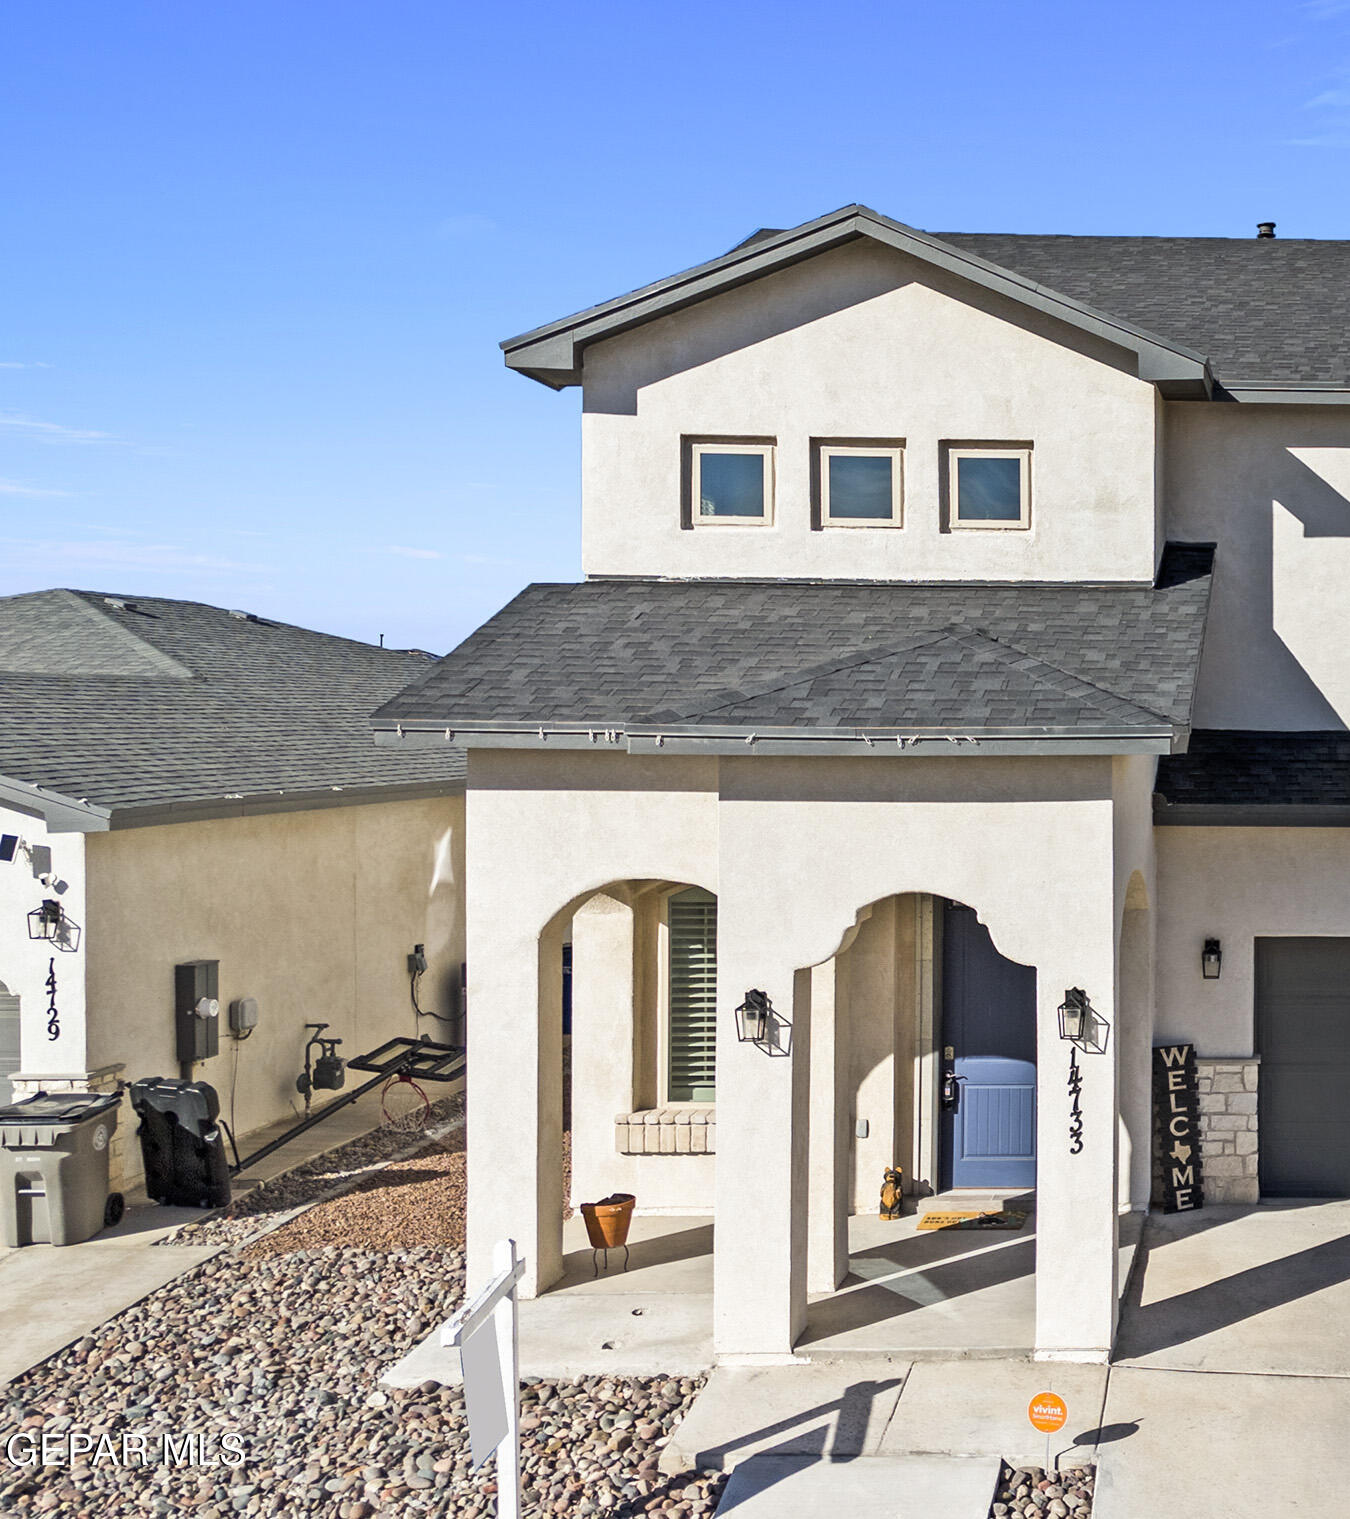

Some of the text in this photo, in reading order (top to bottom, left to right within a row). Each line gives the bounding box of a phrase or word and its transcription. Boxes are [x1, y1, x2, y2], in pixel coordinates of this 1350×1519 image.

[45, 957, 60, 1041] 14729
[1067, 1046, 1084, 1155] 14733
[1160, 1046, 1194, 1209] WELCME
